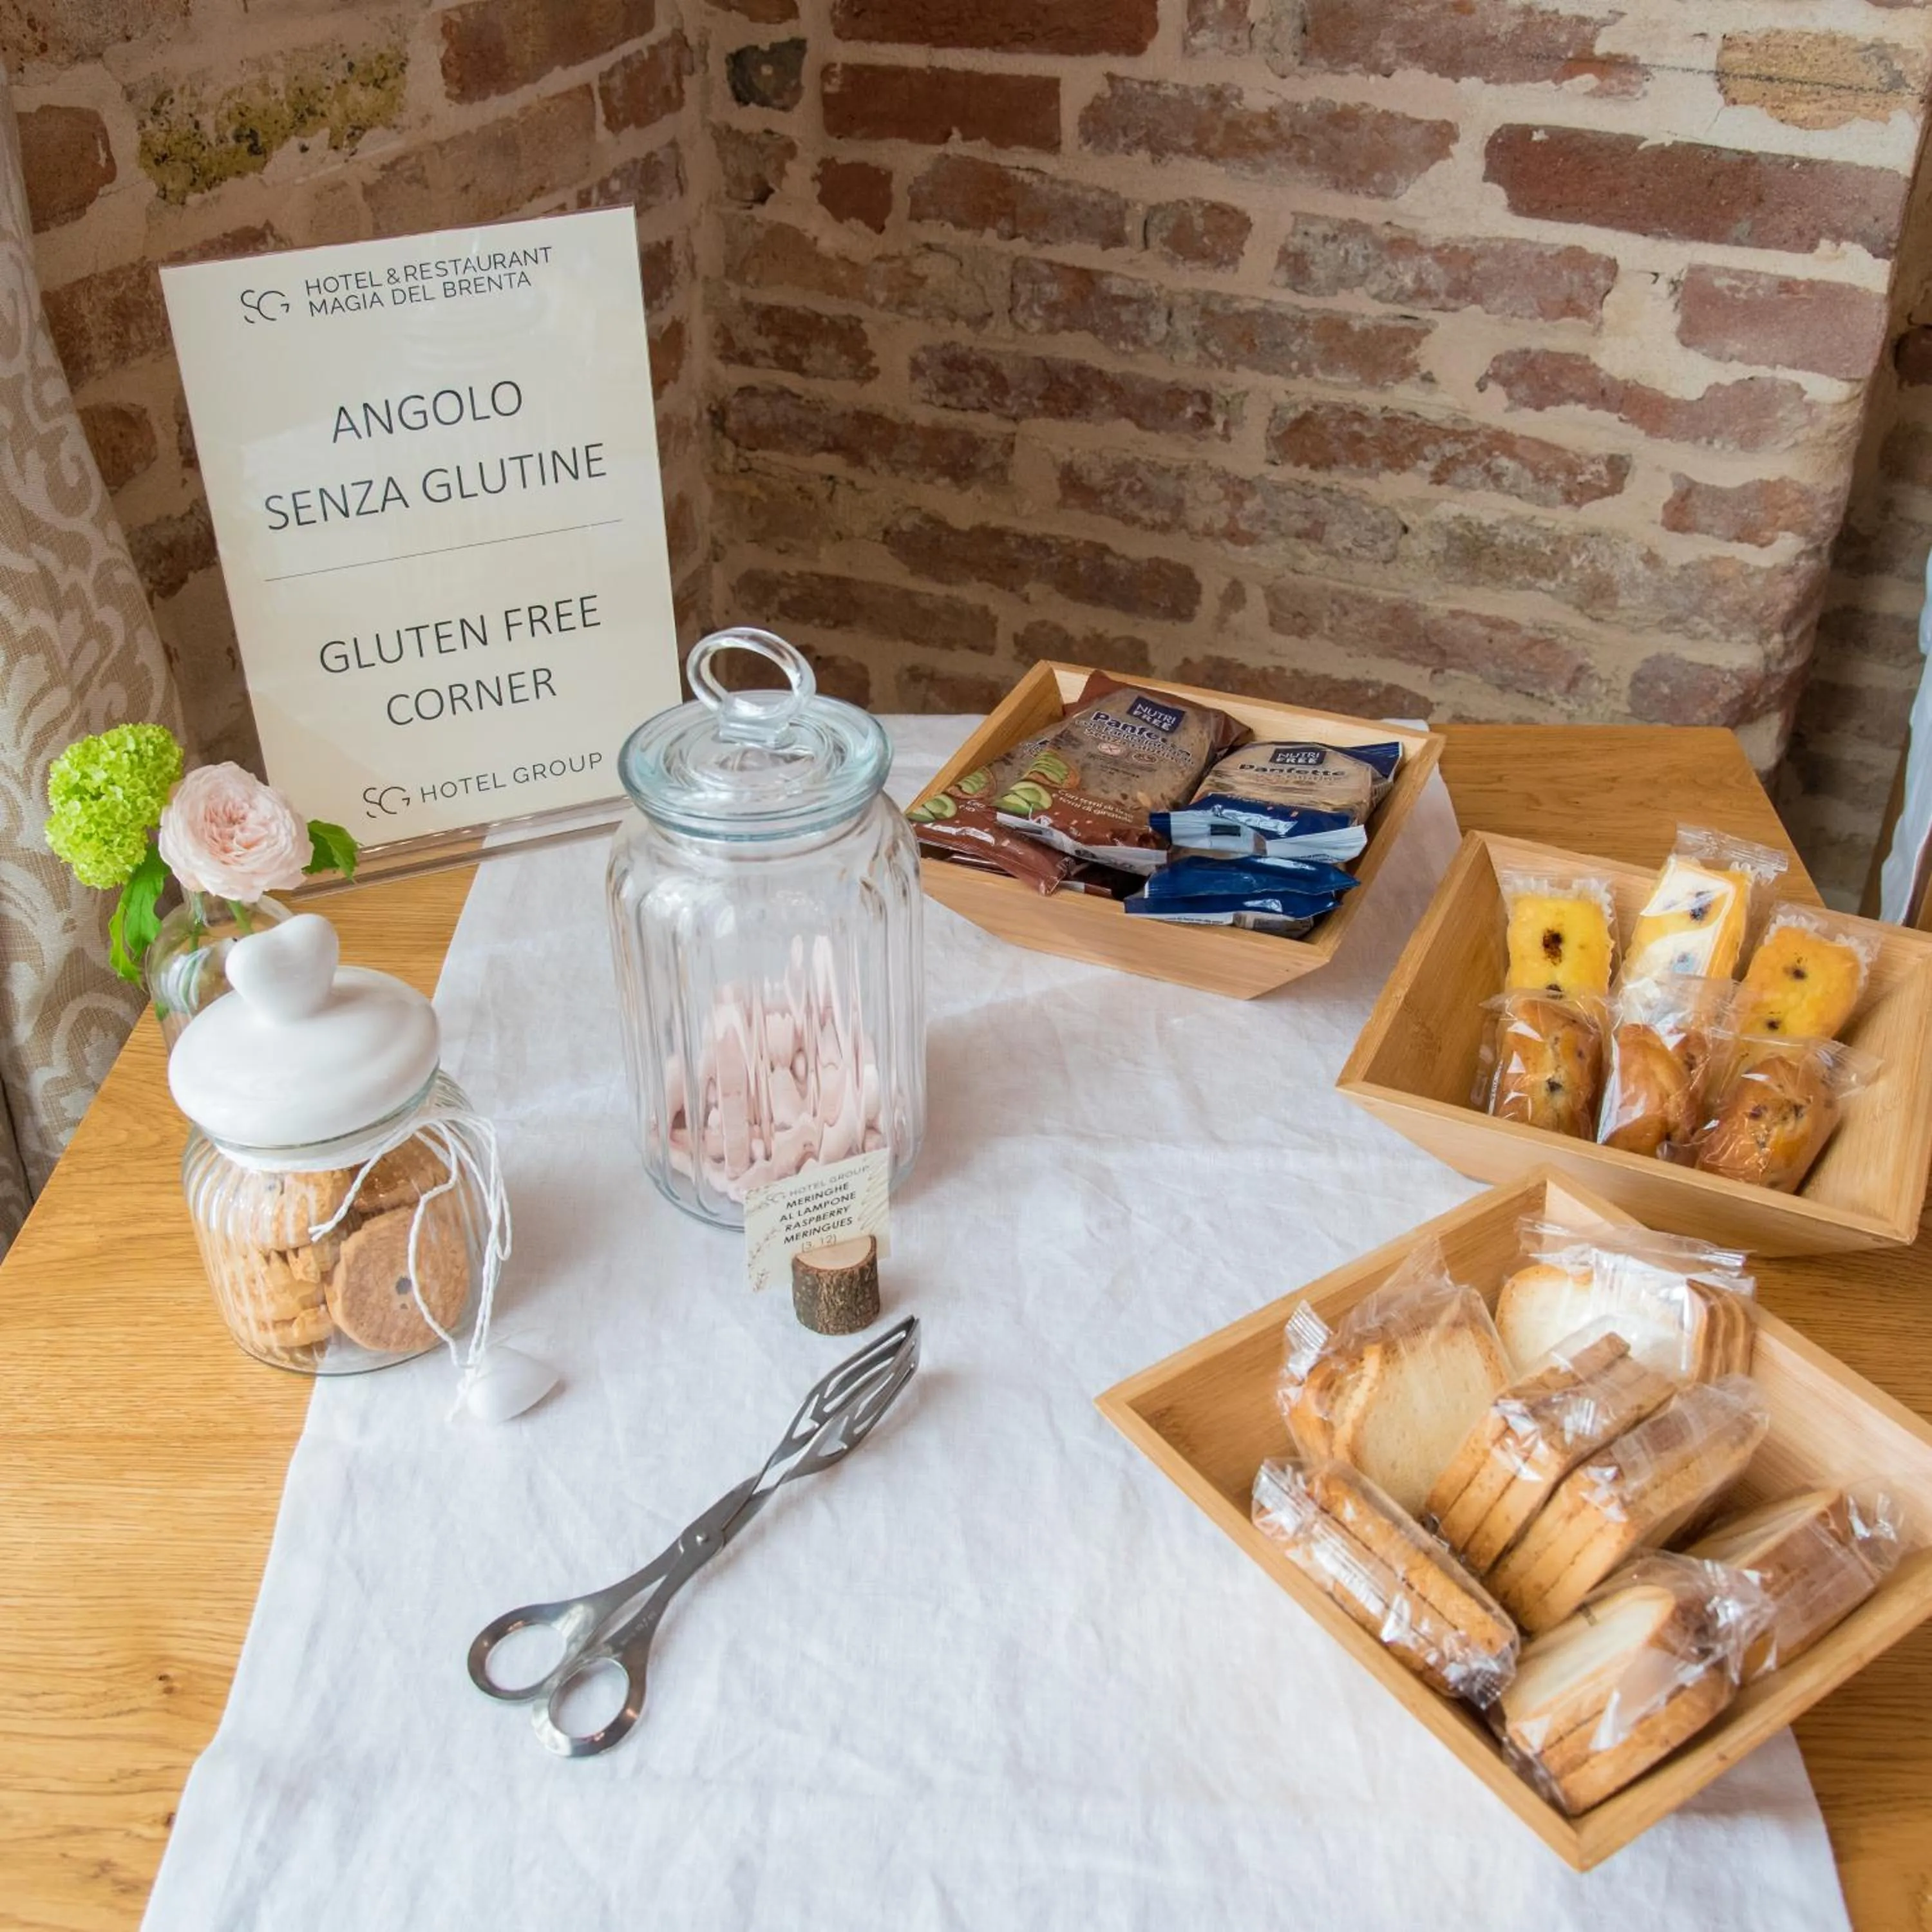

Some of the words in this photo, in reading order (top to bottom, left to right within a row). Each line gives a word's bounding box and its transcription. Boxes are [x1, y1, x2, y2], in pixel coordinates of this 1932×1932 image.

[308, 291, 384, 317] MAGIA
[391, 284, 436, 306] DEL
[442, 270, 532, 298] BRENTA
[332, 380, 522, 444] ANGOLO
[265, 476, 410, 531] SENZA
[422, 442, 607, 504] GLUTINE
[319, 614, 489, 674] GLUTEN
[504, 594, 601, 643] FREE
[386, 667, 557, 726] CORNER
[1132, 710, 1171, 732] FREE
[1135, 703, 1177, 724] NUTRI
[420, 772, 507, 804] HOTEL
[513, 752, 602, 784] GROUP
[786, 1181, 849, 1209] MERINGHE
[790, 1180, 826, 1197] HOTEL
[829, 1164, 871, 1184] GROUP
[779, 1213, 794, 1222] AL
[798, 1191, 857, 1217] LAMPONE
[785, 1205, 851, 1233] RASPBERRY
[783, 1217, 853, 1245] MERINGUES
